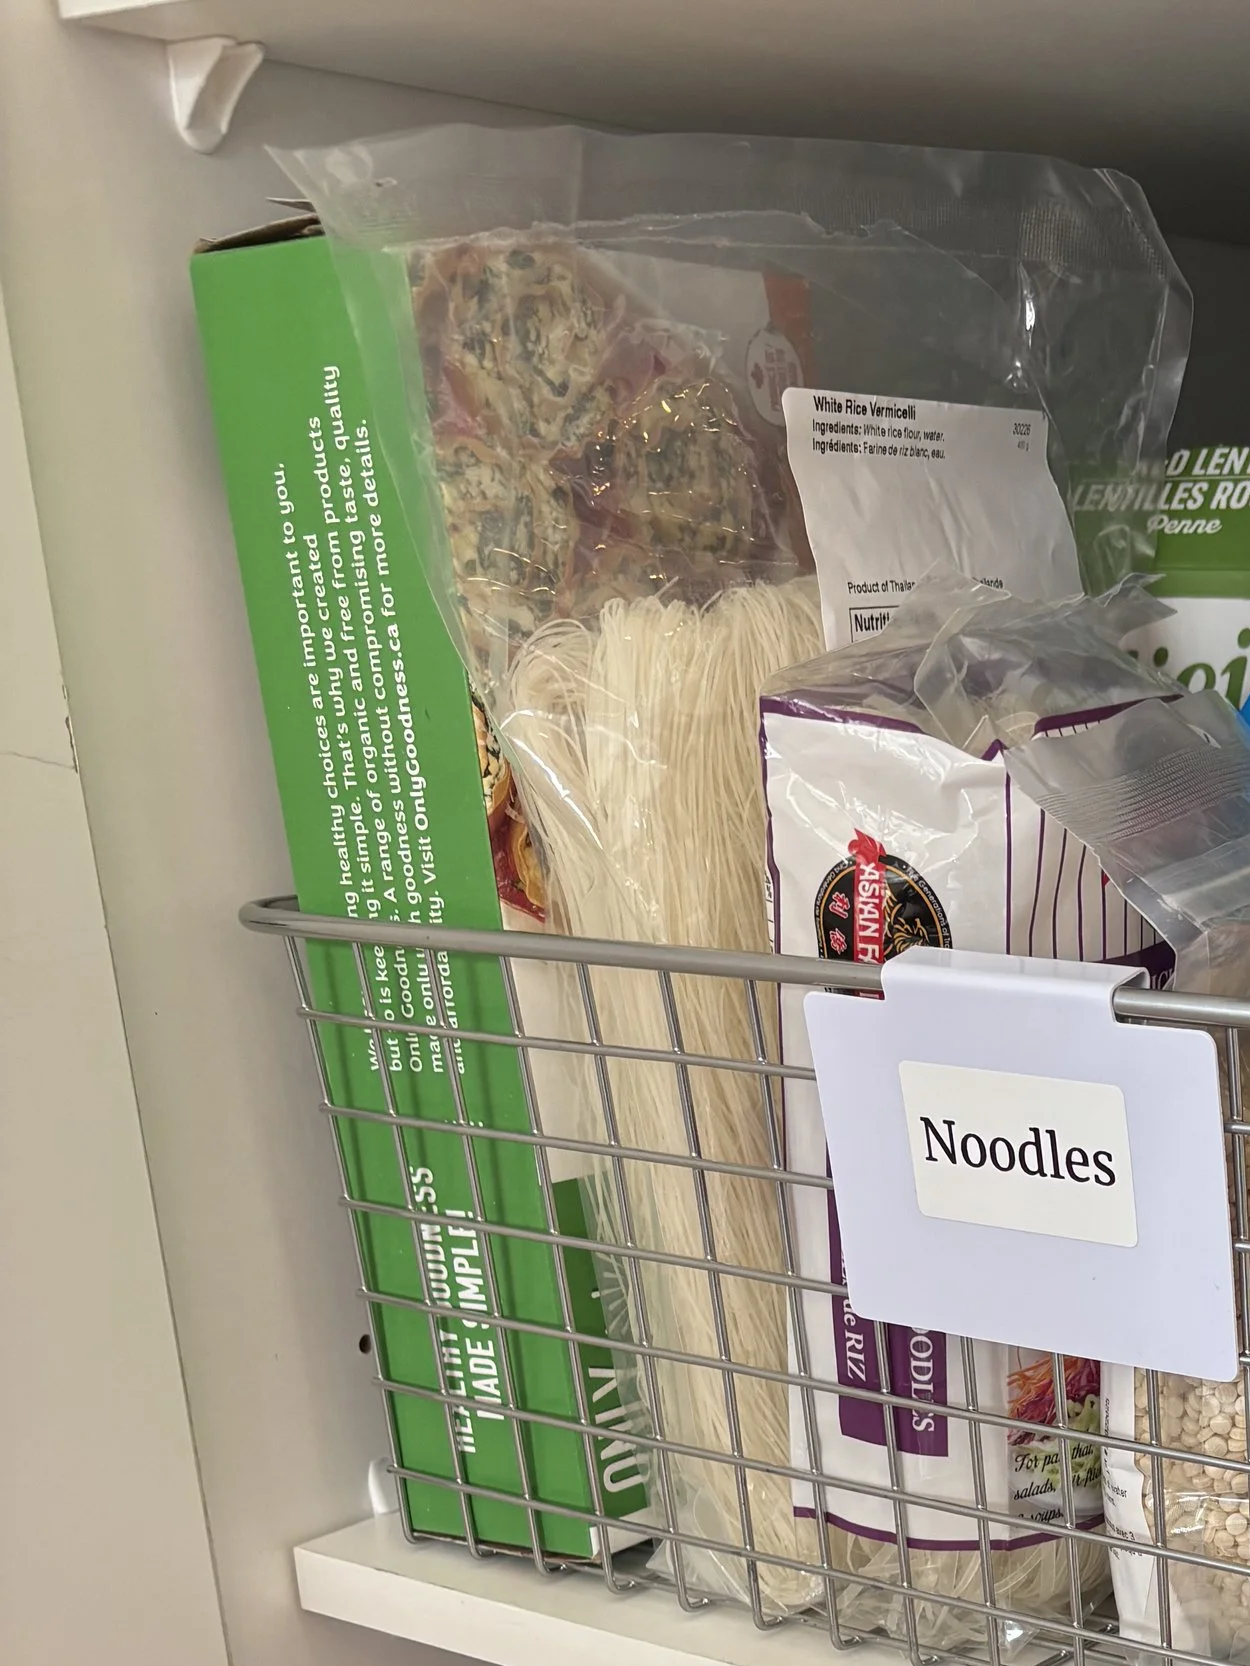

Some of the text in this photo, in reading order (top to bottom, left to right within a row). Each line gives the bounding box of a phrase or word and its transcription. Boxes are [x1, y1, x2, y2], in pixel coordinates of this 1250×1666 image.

[812, 418, 945, 442] Ingredients: White rice water.
[813, 396, 916, 421] White Rice Vermicelli
[812, 438, 908, 456] Ingrédients: Farine de riz
[1146, 514, 1223, 534] Penne
[848, 580, 890, 594] Product of
[309, 416, 398, 903] A range of organic and free from products
[324, 366, 422, 904] goodness without compromising taste, quality
[354, 419, 437, 884] Visit OnlyGoodness.ca for more details.
[274, 463, 354, 885] healthy choices are important to you.
[303, 534, 374, 893] it simple. That's why we created
[858, 863, 880, 938] ASIAN
[918, 880, 946, 924] Generations
[920, 1116, 1118, 1187] Noodles
